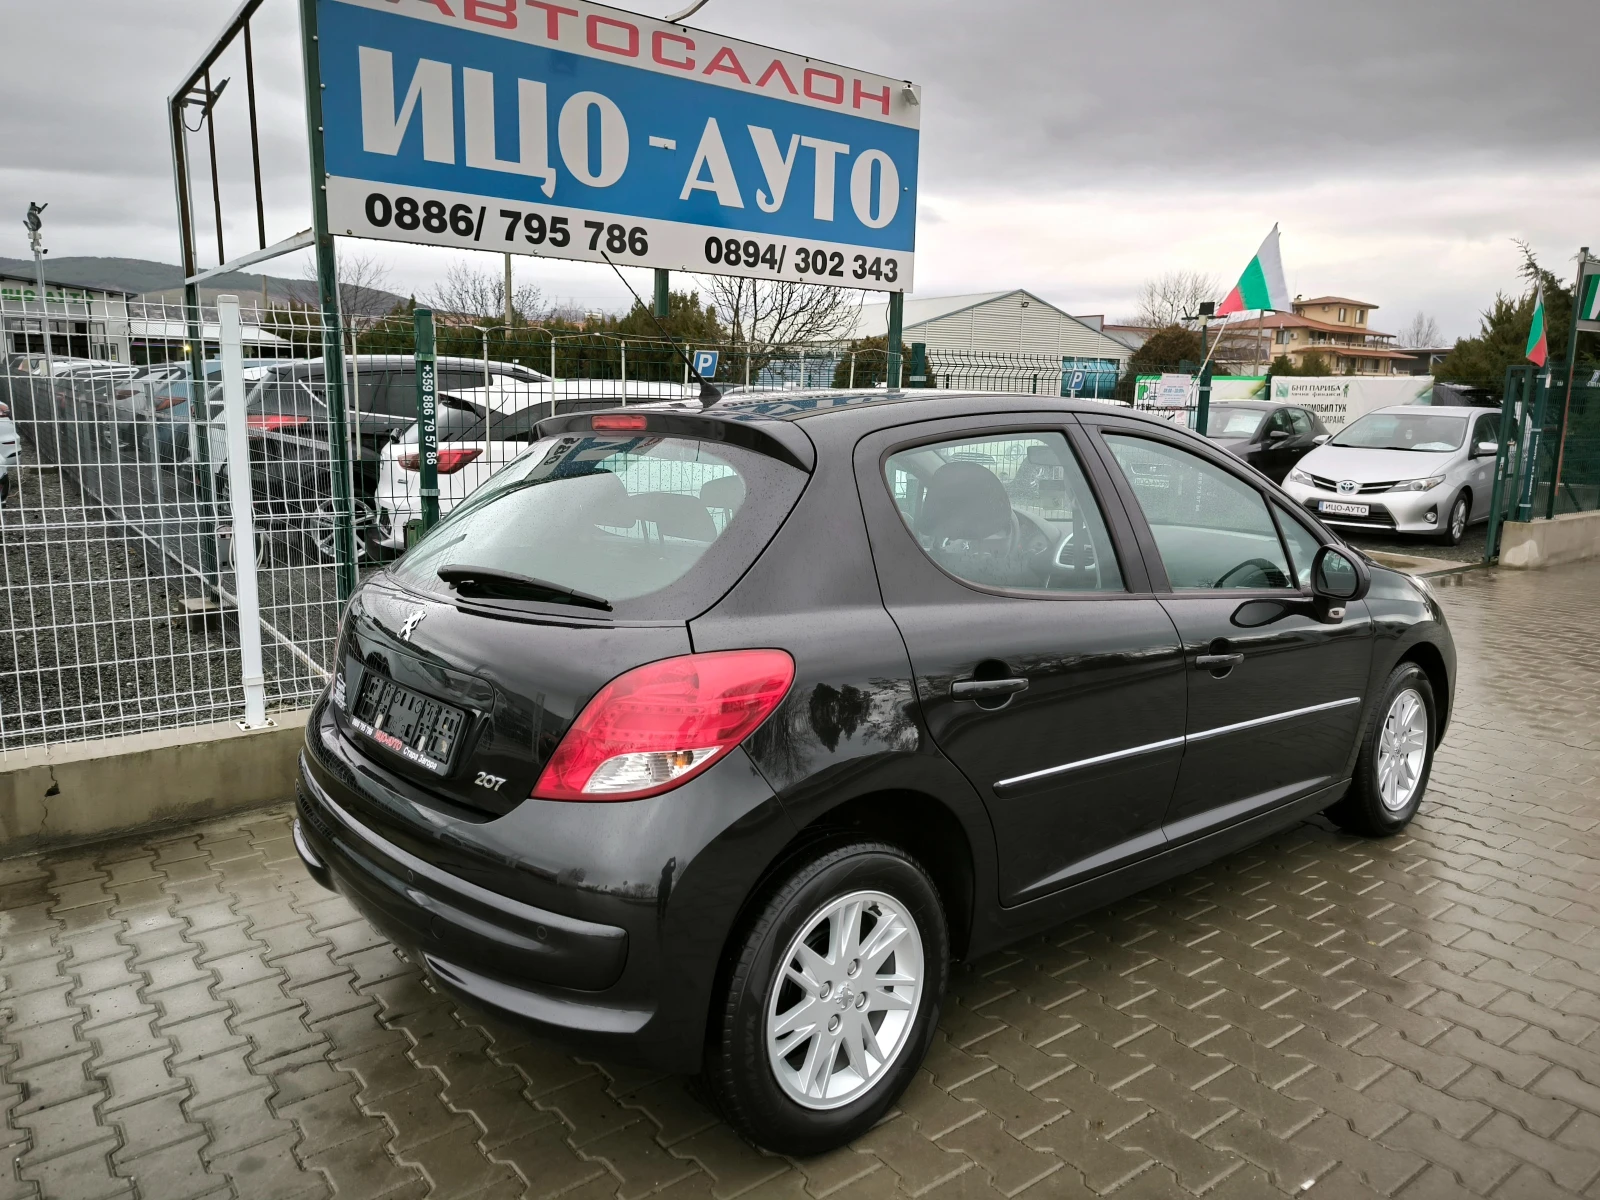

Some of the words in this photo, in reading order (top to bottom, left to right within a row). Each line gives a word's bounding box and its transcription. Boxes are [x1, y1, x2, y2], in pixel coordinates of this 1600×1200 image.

[365, 193, 487, 242] 0886/
[500, 209, 571, 248] 795
[584, 220, 649, 257] 786
[704, 236, 787, 274] 0894/
[794, 247, 844, 278] 302
[852, 254, 899, 284] 343
[697, 353, 713, 374] P
[422, 364, 434, 392] +359
[1071, 371, 1083, 388] P
[1291, 384, 1308, 392] БНП
[1309, 384, 1341, 392] ПАРИБА
[422, 395, 434, 416] 886
[424, 418, 435, 432] 79
[425, 435, 436, 449] 57
[426, 451, 437, 465] 86
[1325, 503, 1367, 514] ИЦО-АУТО
[474, 771, 507, 791] 207
